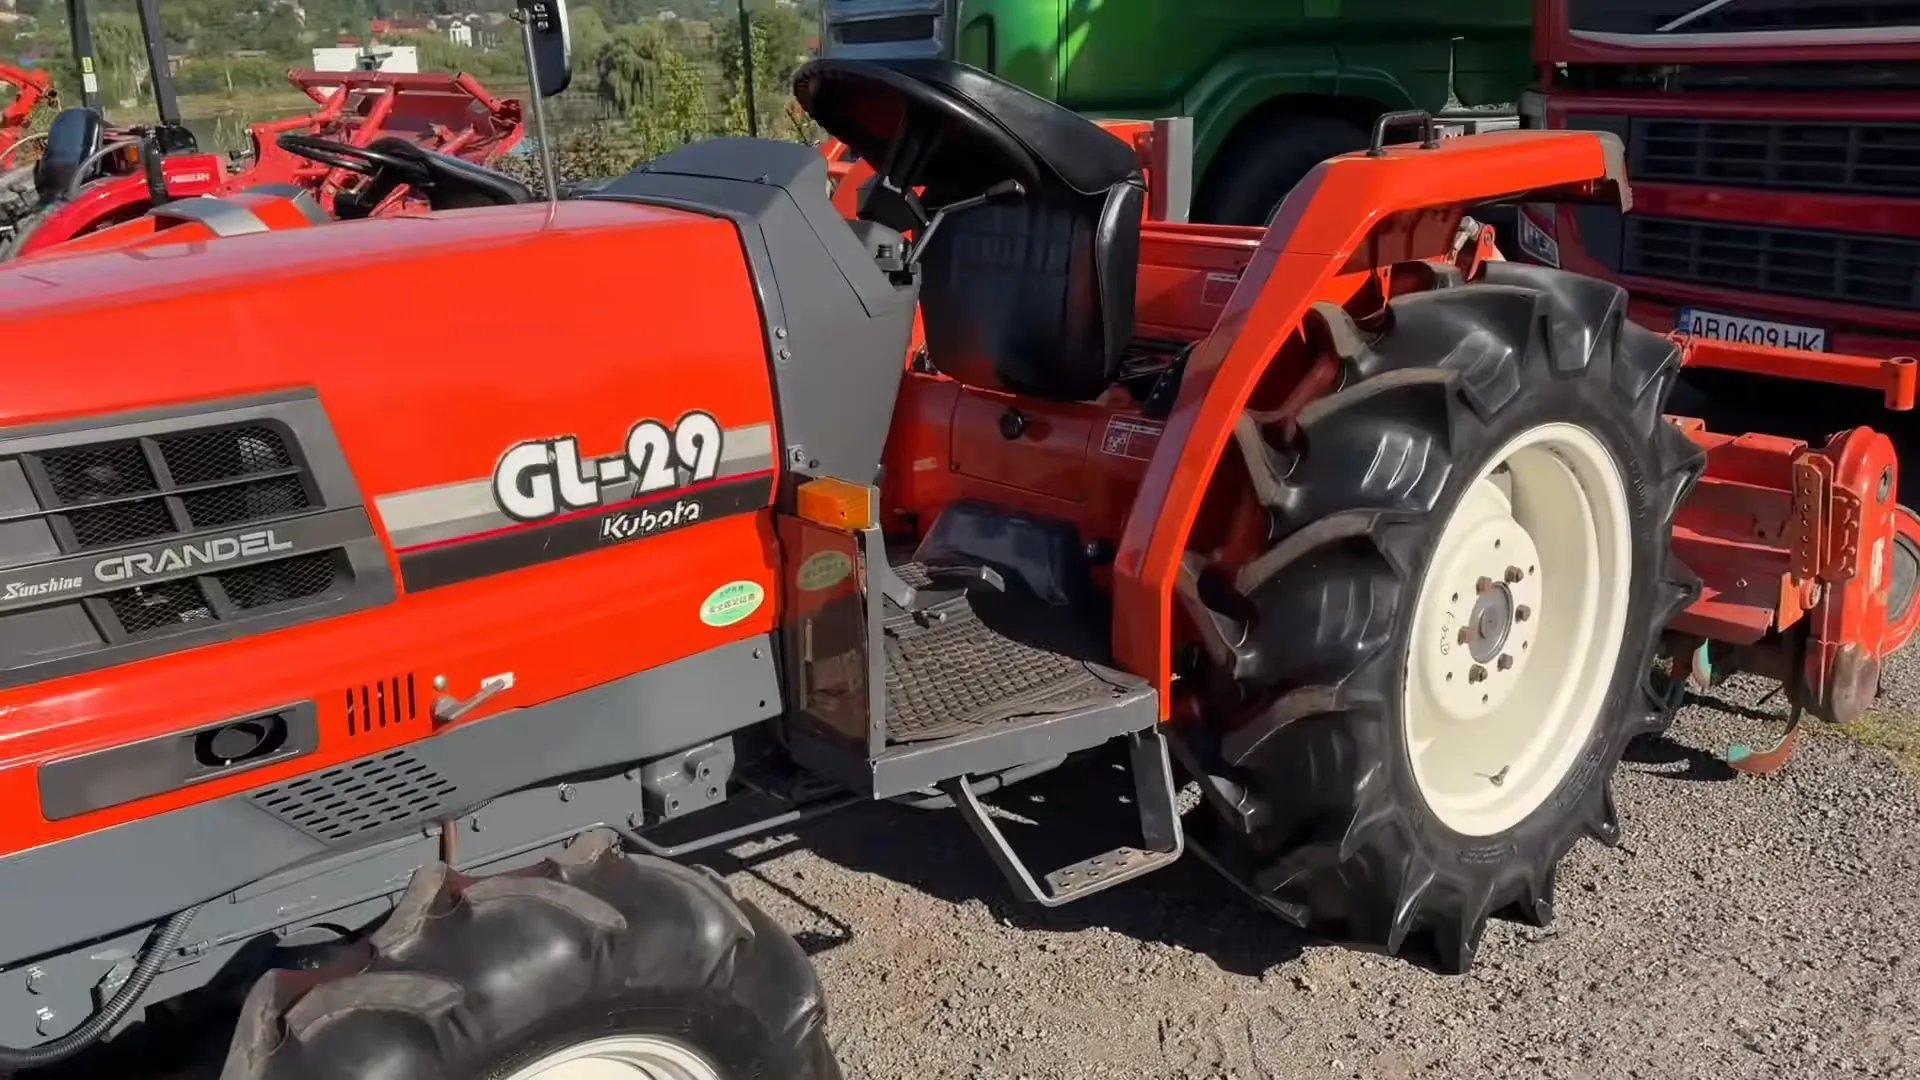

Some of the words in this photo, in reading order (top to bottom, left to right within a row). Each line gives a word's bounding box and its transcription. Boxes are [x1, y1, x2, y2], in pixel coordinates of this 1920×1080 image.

[495, 411, 720, 520] GL-29
[602, 499, 702, 540] Kubota
[2, 574, 83, 600] Sunshine
[94, 529, 292, 583] GRANDEL
